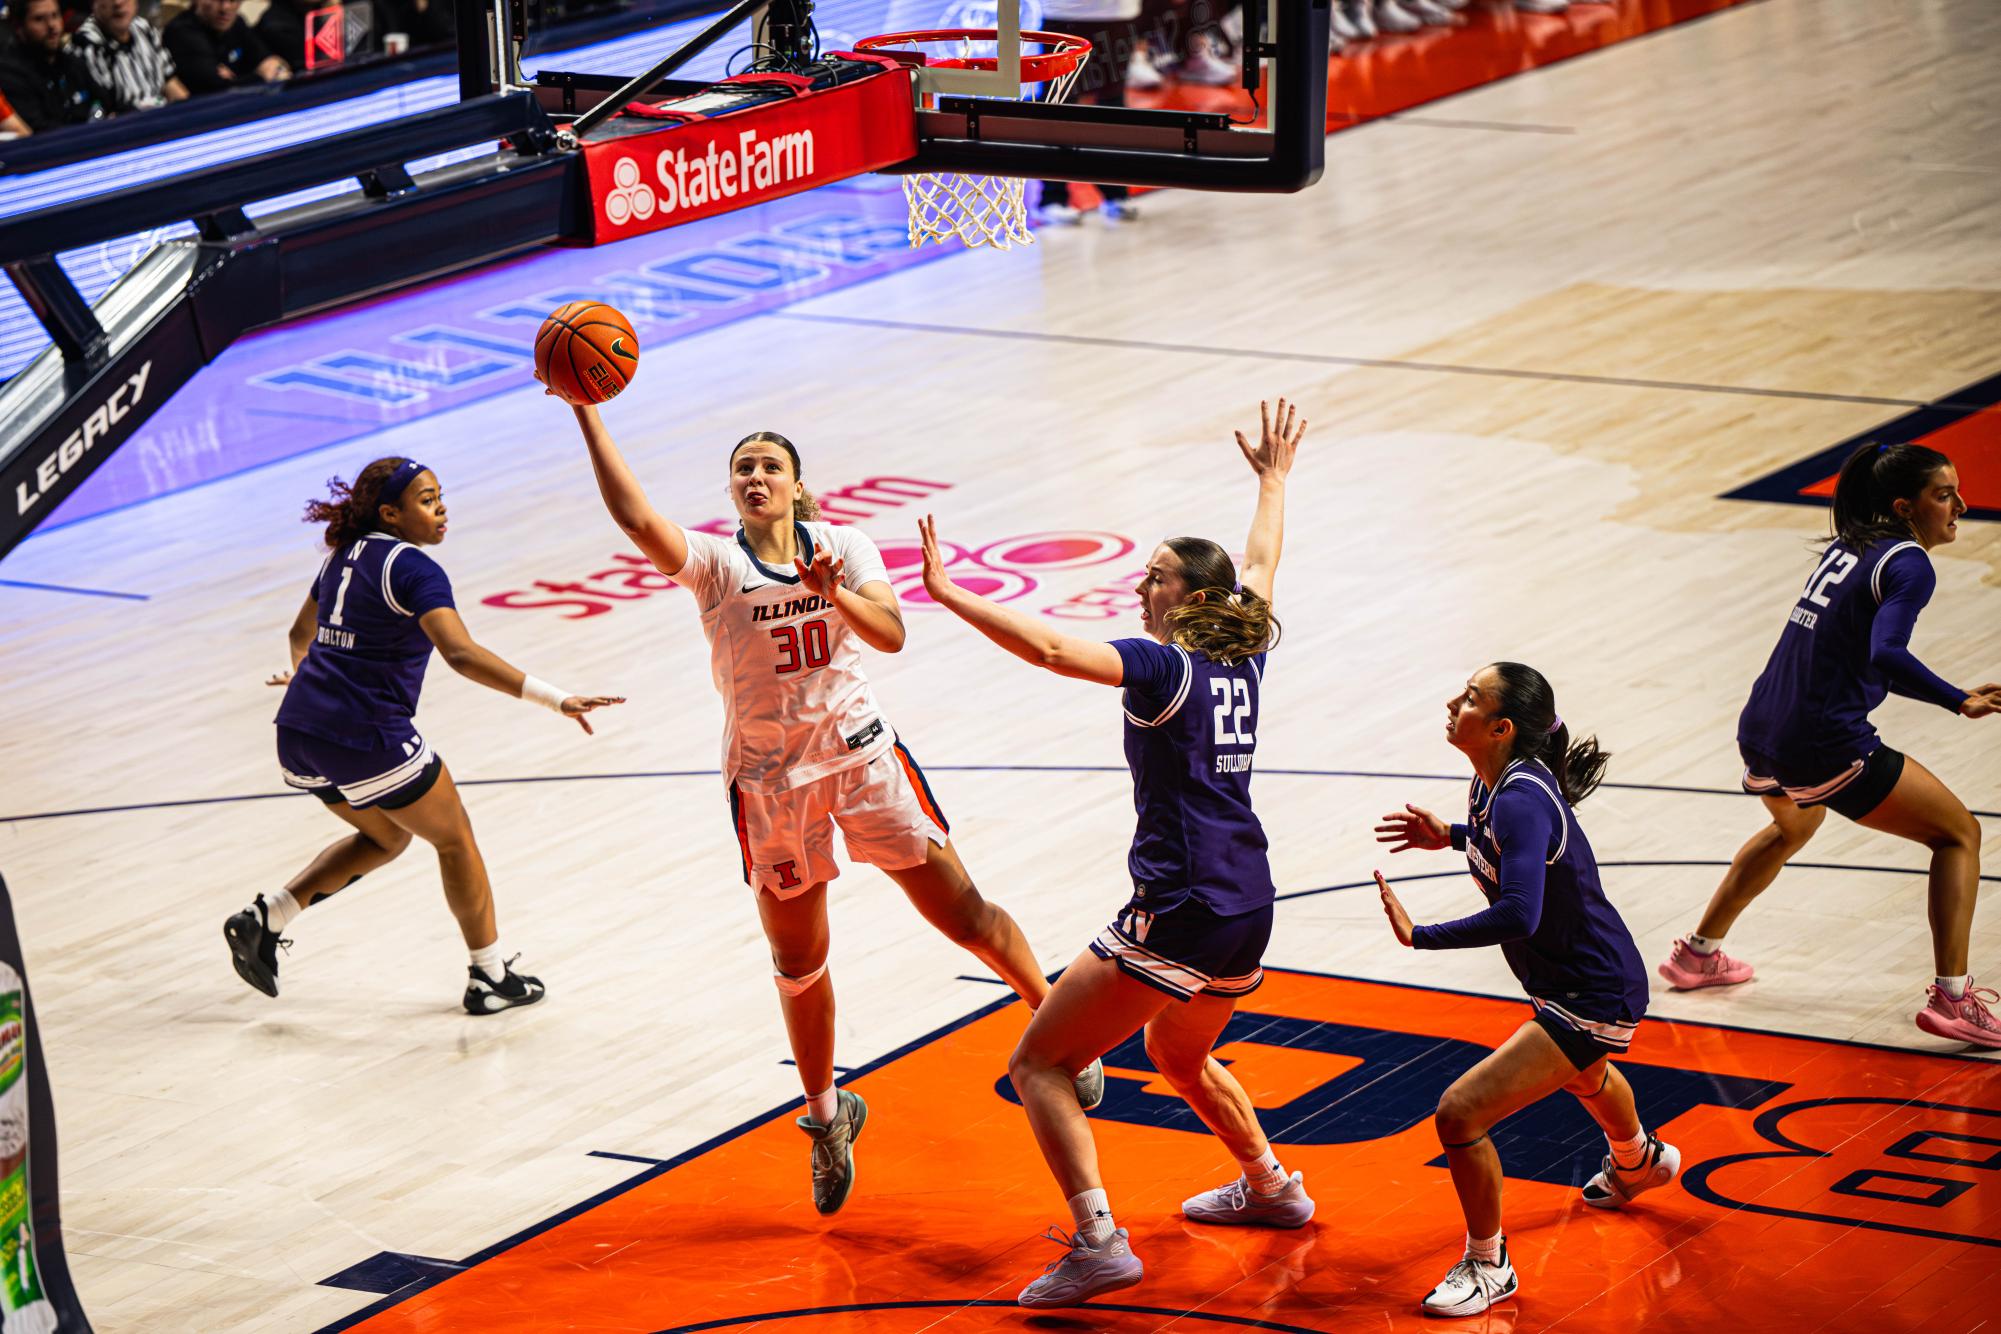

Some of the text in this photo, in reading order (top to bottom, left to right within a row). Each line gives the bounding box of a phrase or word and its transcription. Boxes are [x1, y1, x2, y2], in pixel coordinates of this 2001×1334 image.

[16, 359, 152, 515] LEGACY
[329, 566, 353, 625] 1
[1802, 549, 1859, 608] 12
[771, 619, 831, 674] 30
[1209, 677, 1254, 744] 22
[773, 860, 802, 890] I
